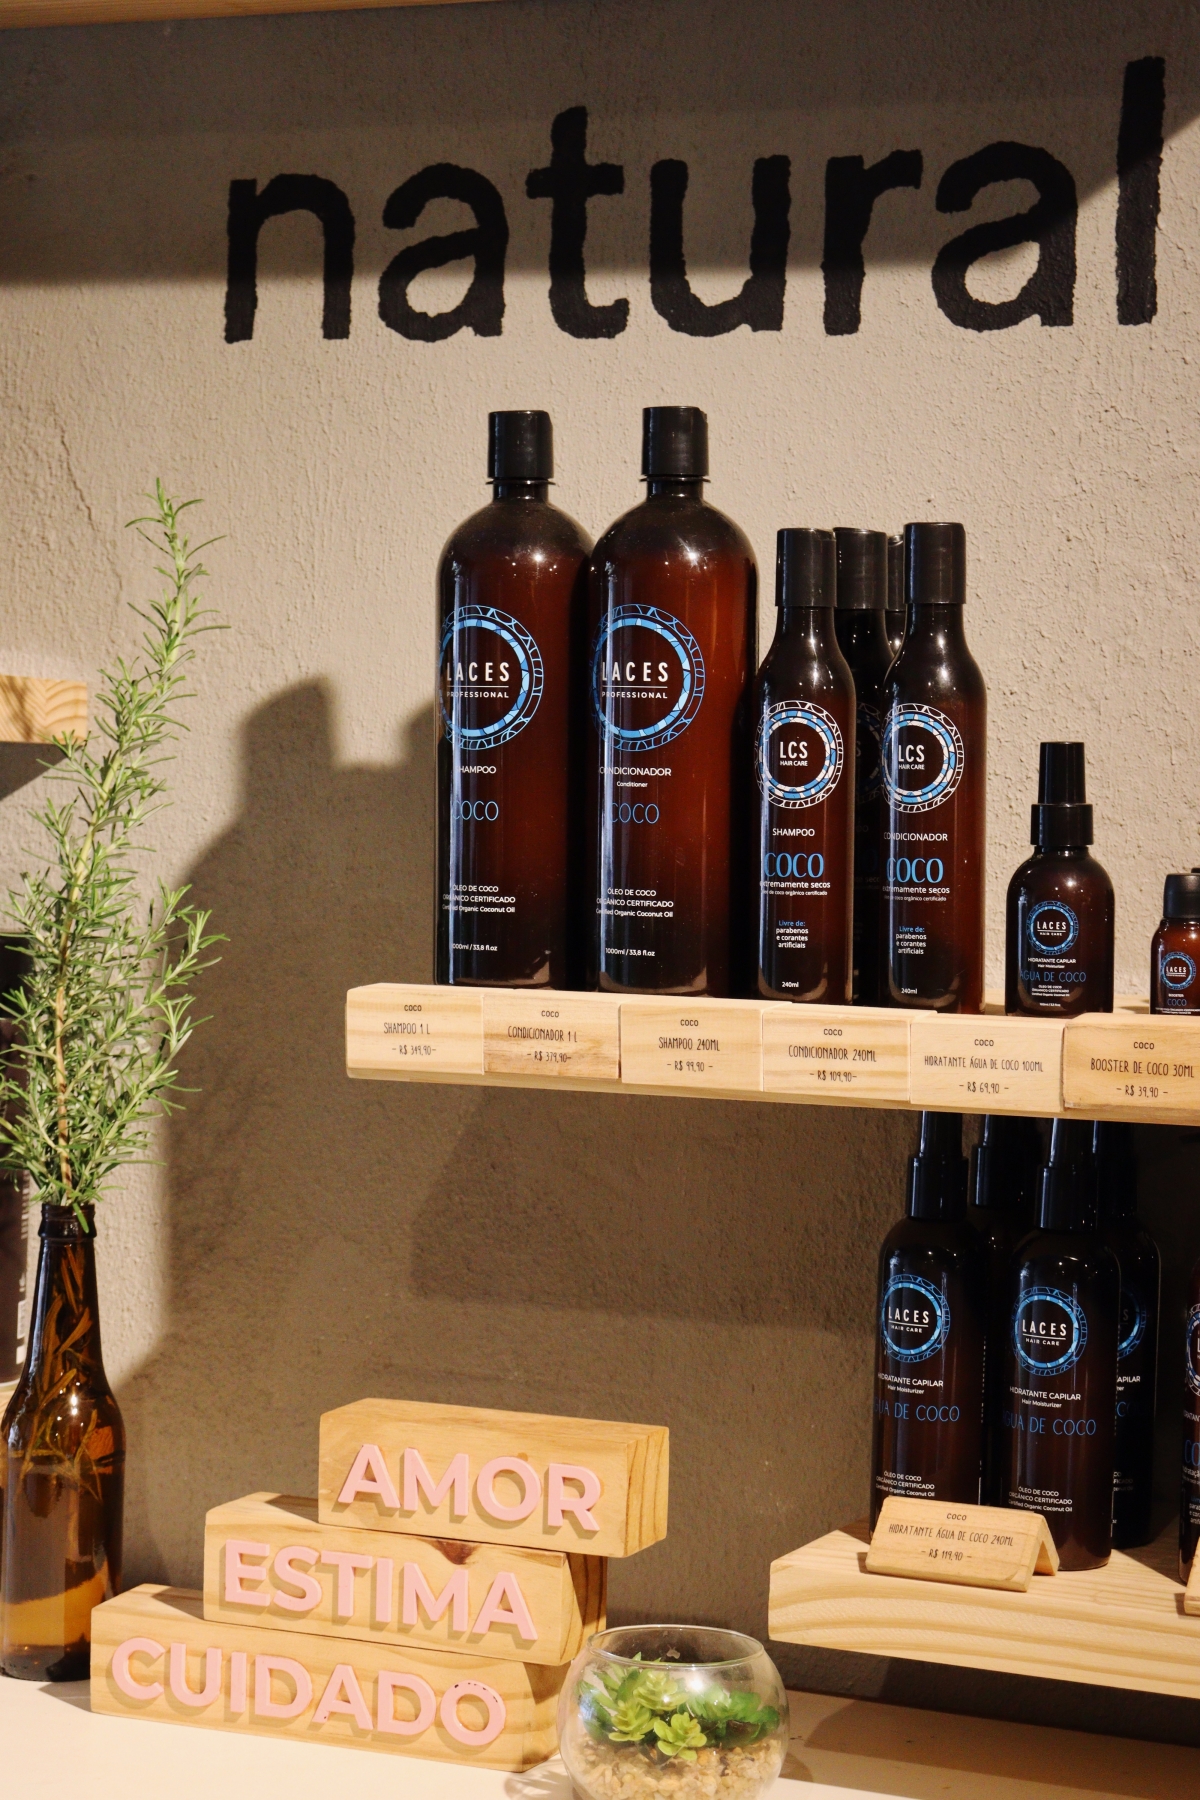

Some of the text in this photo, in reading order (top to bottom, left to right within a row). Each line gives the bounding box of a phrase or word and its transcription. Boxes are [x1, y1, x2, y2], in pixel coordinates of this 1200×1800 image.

[224, 55, 1166, 343] natural
[447, 662, 510, 682] LACES
[602, 662, 668, 682] LACES
[602, 691, 668, 699] PROFESSIONAL
[779, 741, 808, 759] LCS
[899, 744, 925, 763] LCS
[455, 766, 497, 774] HAMPOO
[772, 827, 816, 837] SHAMPOO
[883, 832, 949, 841] CONDICIONADOR
[764, 852, 825, 878] COCO
[886, 857, 944, 883] COCO
[478, 885, 499, 893] COCO
[607, 887, 623, 895] ÓLEO
[635, 889, 657, 897] COCO
[928, 886, 950, 894] secos
[469, 895, 516, 903] CERTIFICADO
[626, 899, 674, 908] CERTIFICADO
[614, 909, 636, 917] Organic
[1036, 921, 1067, 930] LACES
[605, 947, 625, 955] 1000ml
[778, 941, 806, 949] artificiais
[897, 947, 924, 955] artificiais
[1043, 971, 1087, 983] DE COCO
[1166, 998, 1188, 1007] COCO
[383, 1022, 417, 1034] SHAMPOO
[507, 1025, 564, 1041] CONDICIONADOR
[399, 1044, 408, 1055] R$
[658, 1036, 721, 1052] SHAMPOO 240ML
[534, 1050, 543, 1062] R$
[788, 1044, 877, 1062] CONDICIONADOR 240ML
[674, 1060, 683, 1071] R$
[924, 1055, 1044, 1072] HIDRATANTE ÁGUA DE COCO 100ML
[1090, 1057, 1195, 1078] BOOSTER DE COCO 30ML
[817, 1069, 826, 1081] R$
[967, 1081, 977, 1093] R$
[1124, 1084, 1135, 1096] R$
[888, 1306, 930, 1324] LACES
[1022, 1319, 1067, 1336] LACES
[877, 1372, 944, 1387] HIDRATANTE CAPILAR
[1116, 1375, 1141, 1383] APILAR
[896, 1385, 925, 1394] Moisturizer
[1009, 1386, 1081, 1401] HIDRATANTE CAPILAR
[1032, 1400, 1062, 1408] Moisturizer
[894, 1402, 960, 1422] DE COCO
[1029, 1416, 1097, 1436] DE COCO
[884, 1470, 896, 1478] ÓLEO
[904, 1474, 922, 1482] COCO
[338, 1443, 602, 1532] AMOR
[889, 1486, 906, 1495] Organic
[898, 1481, 935, 1490] CERTIFICADO
[1018, 1485, 1032, 1494] ÓLEO
[1034, 1497, 1073, 1505] CERTIFICADO
[888, 1523, 1014, 1547] HIDRATANTE ÁGUA DE COCO 240ML
[928, 1548, 938, 1559] R$
[223, 1538, 539, 1641] ESTIMA
[111, 1636, 507, 1747] CUIDADO
